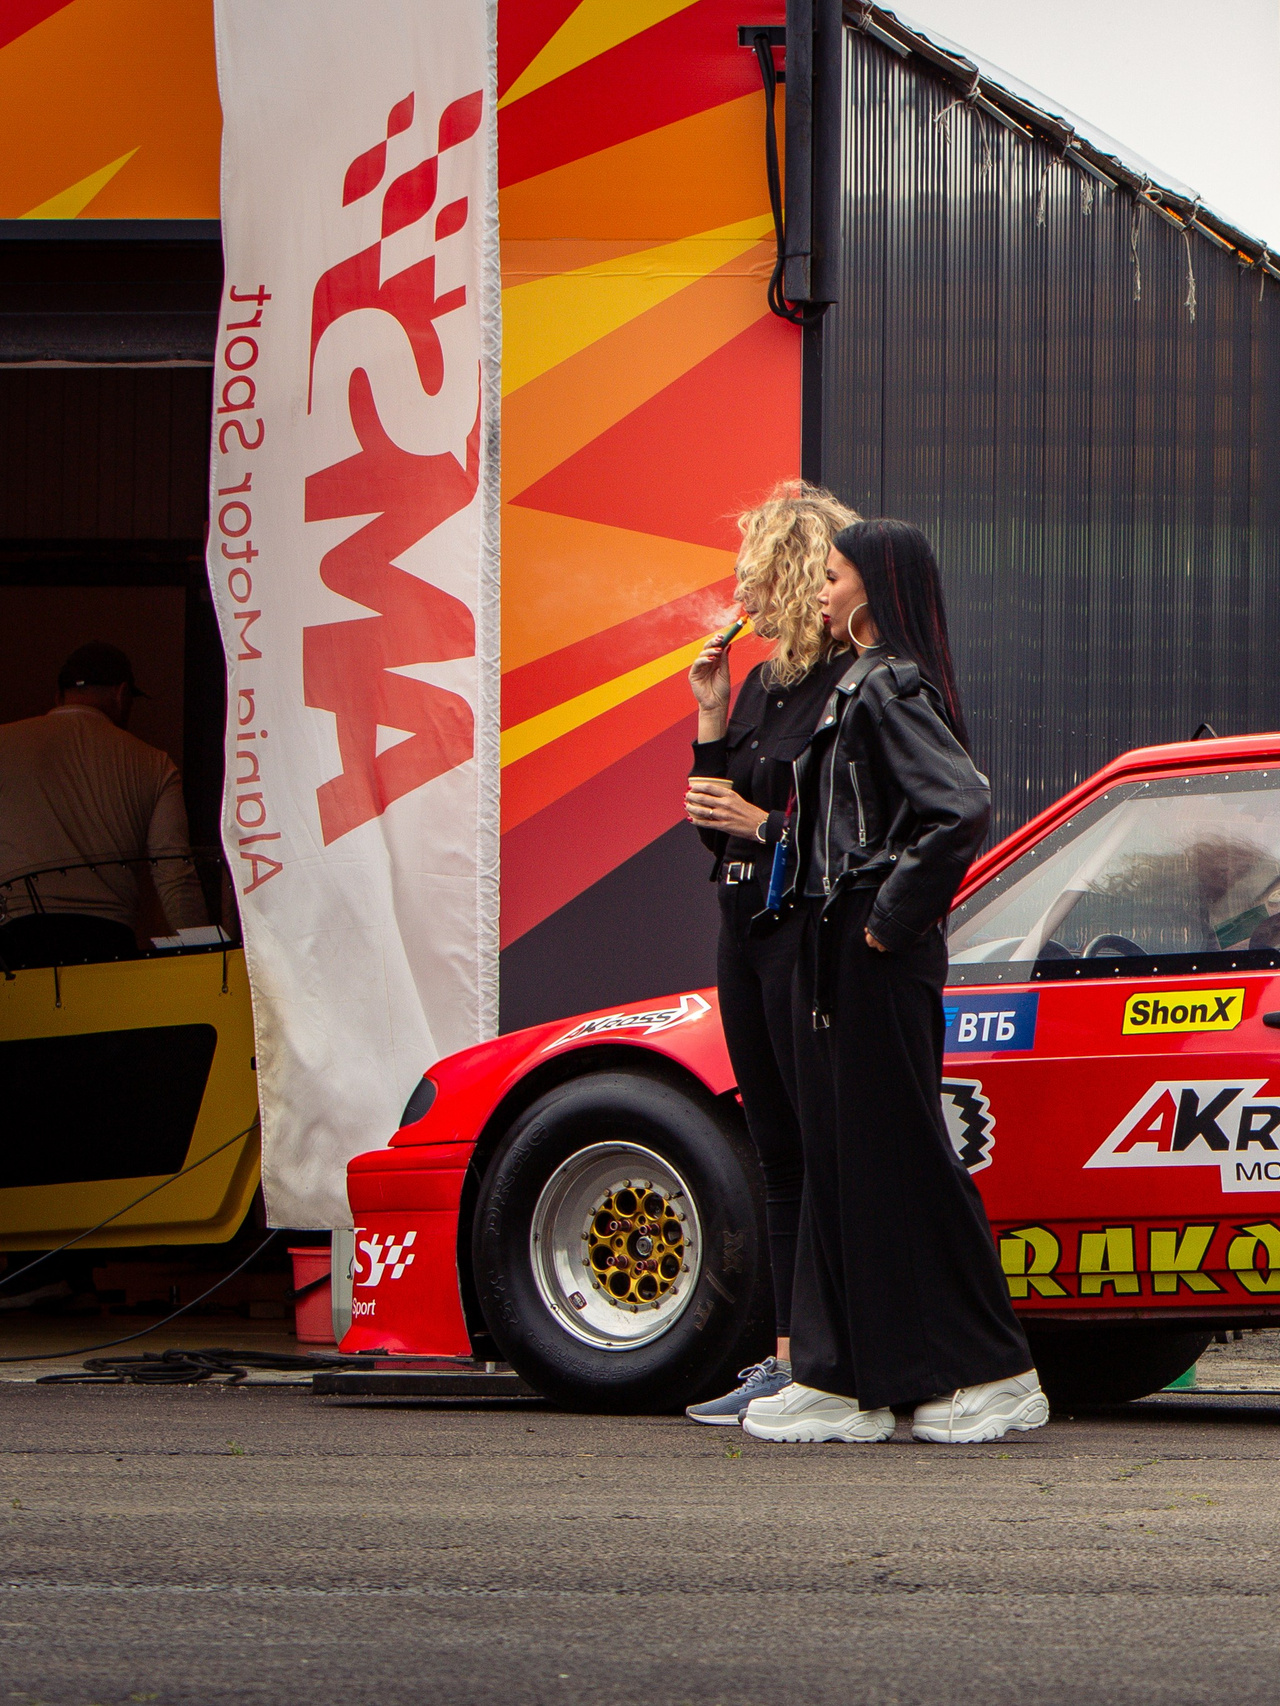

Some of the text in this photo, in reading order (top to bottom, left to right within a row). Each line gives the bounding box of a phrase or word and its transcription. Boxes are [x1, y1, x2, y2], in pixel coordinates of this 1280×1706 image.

[1130, 996, 1237, 1026] ShonX
[957, 1010, 1017, 1043] ВТБ
[352, 1297, 376, 1319] Sport
